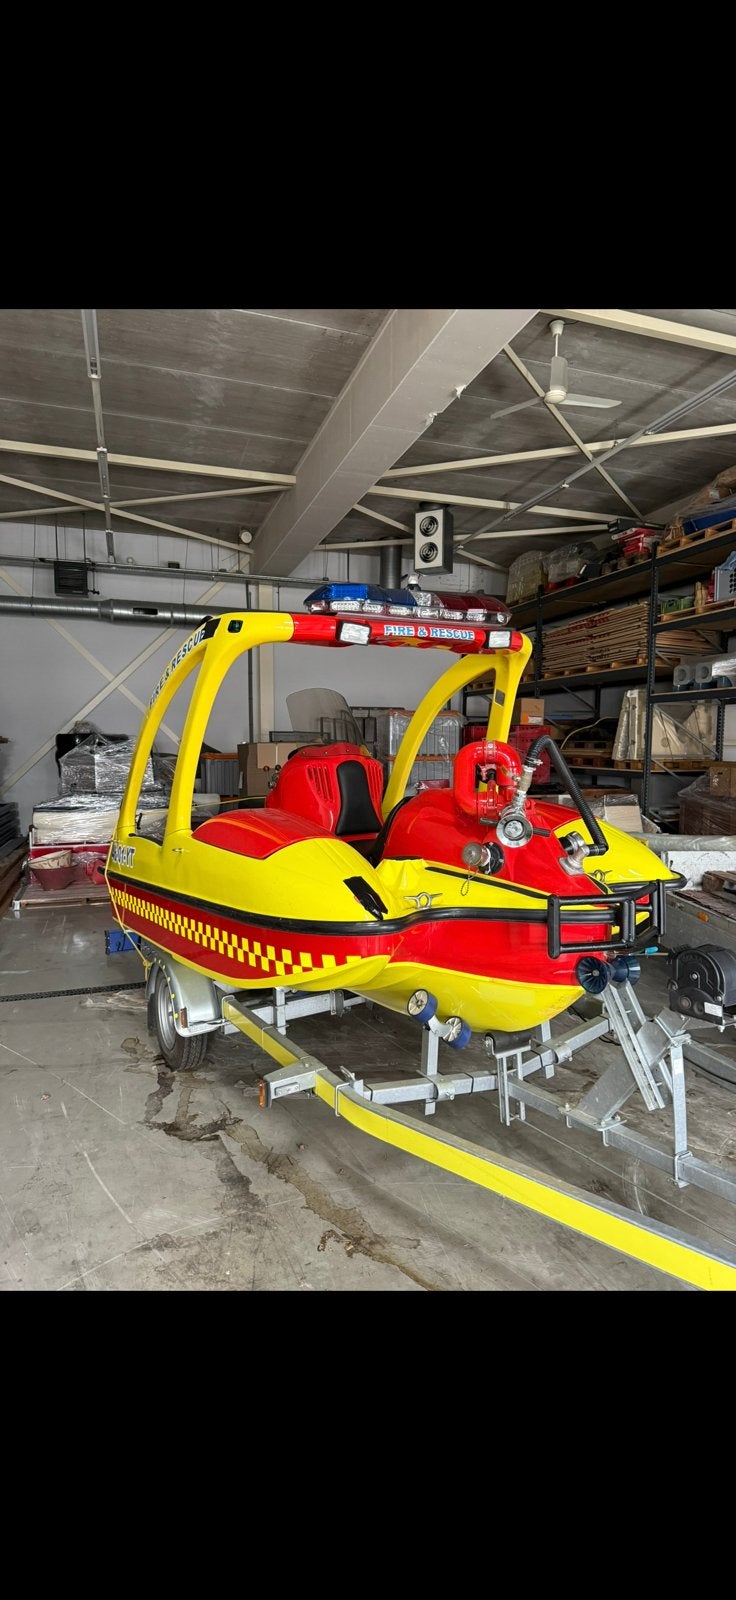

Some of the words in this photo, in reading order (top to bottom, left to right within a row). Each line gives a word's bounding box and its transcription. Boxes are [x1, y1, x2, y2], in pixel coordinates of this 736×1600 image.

[384, 625, 414, 636] FIRE
[418, 626, 428, 637] &
[430, 627, 475, 640] RESCUE
